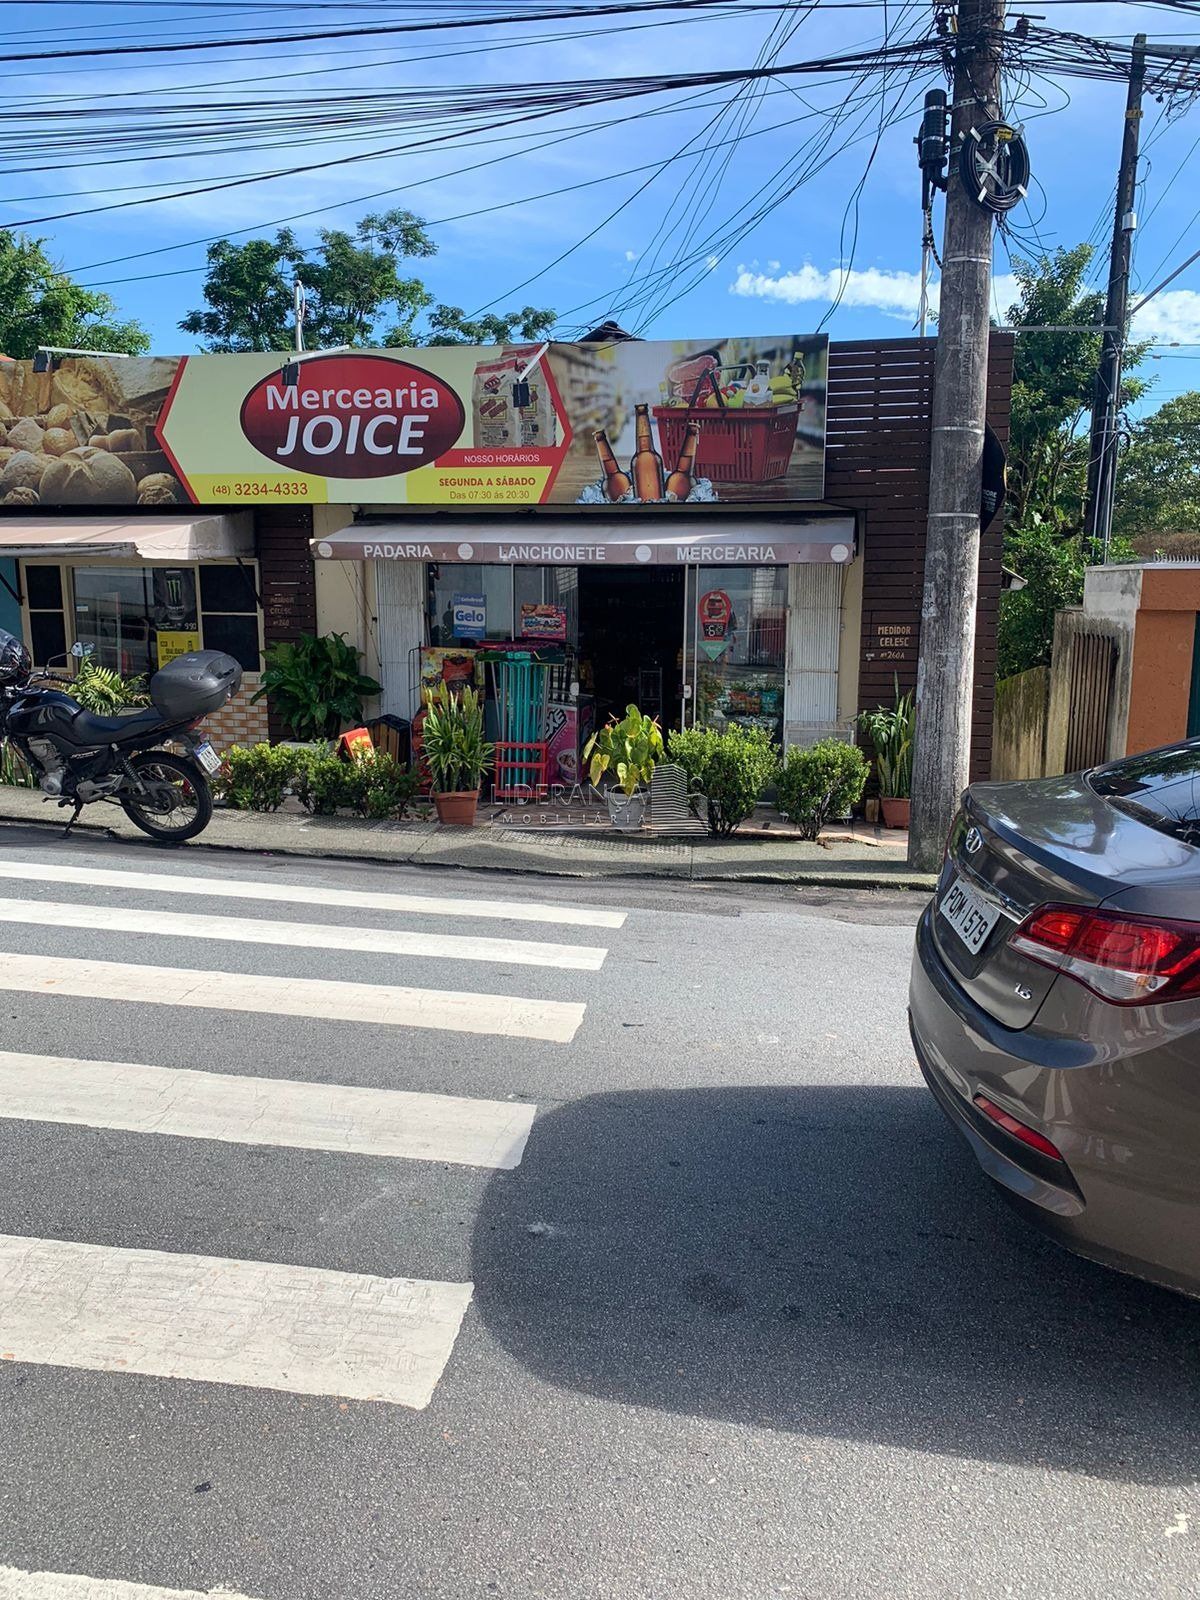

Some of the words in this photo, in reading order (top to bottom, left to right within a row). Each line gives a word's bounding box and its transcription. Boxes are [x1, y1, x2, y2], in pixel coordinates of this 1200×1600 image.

[266, 381, 439, 410] Mercearia
[276, 414, 430, 456] JOICE
[464, 455, 494, 463] NOSSO
[495, 453, 540, 463] HORÁRIOS
[439, 478, 484, 486] SEGUNDA
[486, 478, 493, 486] A
[496, 475, 536, 486] SÁBADO
[212, 484, 231, 496] (48)
[234, 482, 308, 496] 3234-4333
[450, 491, 466, 499] Das
[468, 490, 492, 499] 07:30
[506, 490, 530, 499] 20:30
[363, 544, 433, 558] PADARIA
[499, 545, 605, 560] LANCHONETE
[677, 546, 777, 561] MERCEARIA
[455, 610, 484, 622] Gelo
[877, 626, 911, 635] MEDIDOR
[880, 637, 910, 647] CELESC
